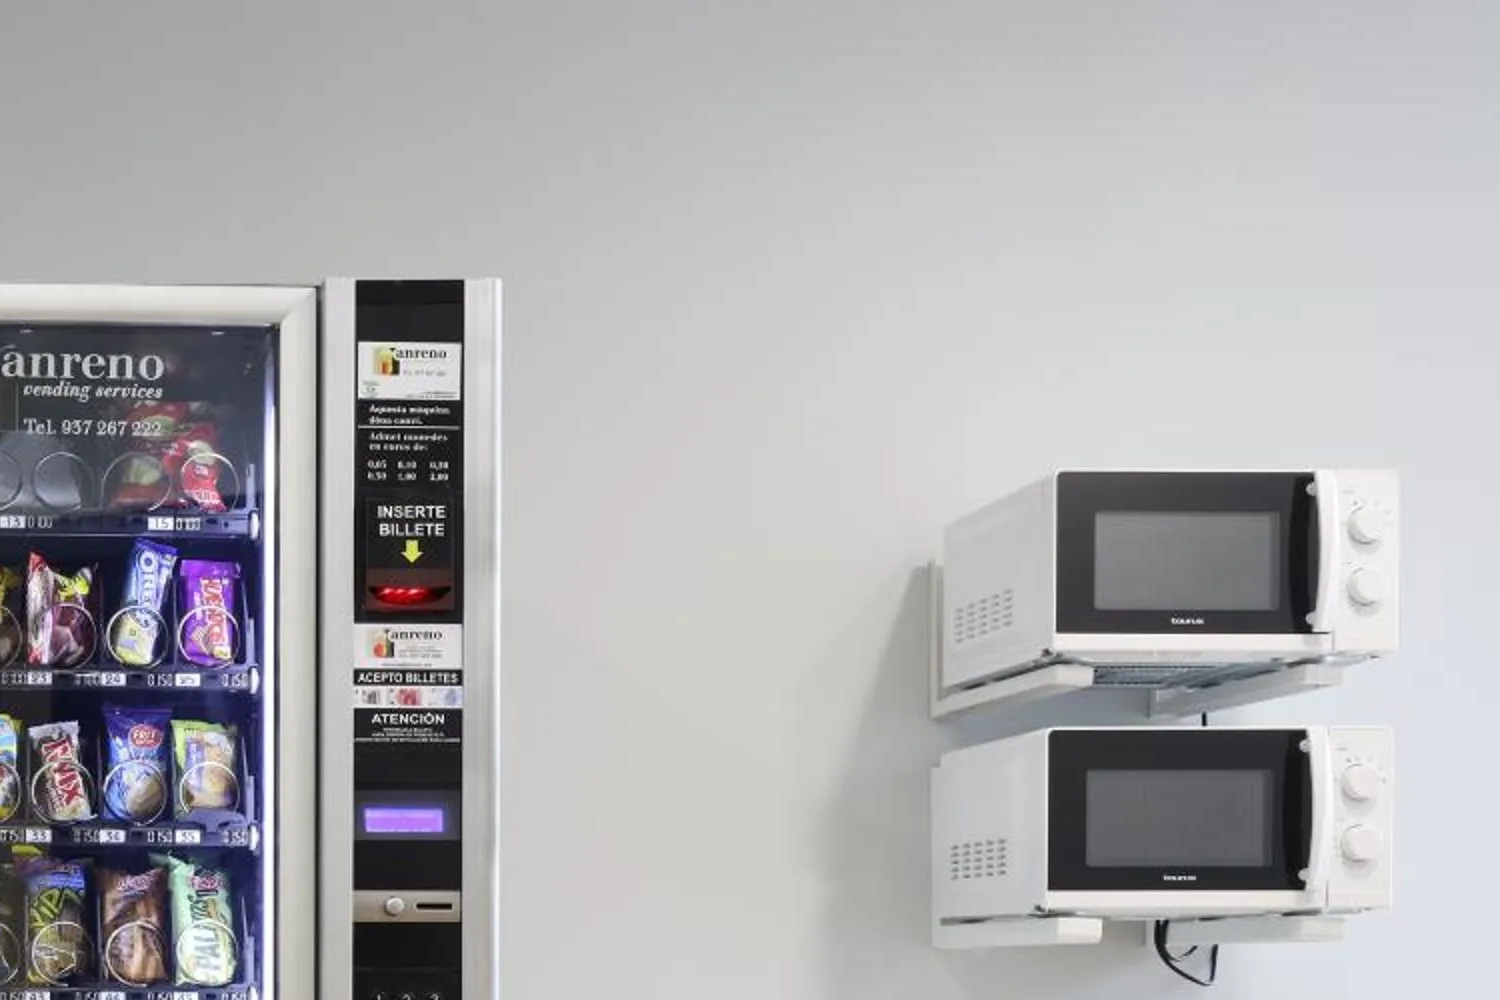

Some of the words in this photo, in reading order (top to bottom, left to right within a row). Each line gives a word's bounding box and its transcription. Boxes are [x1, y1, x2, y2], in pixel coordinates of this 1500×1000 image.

[395, 349, 447, 359] anreno
[1, 352, 165, 380] anreno
[23, 381, 92, 403] vending
[95, 384, 163, 399] services
[61, 420, 93, 435] 937
[96, 421, 127, 436] 267
[132, 422, 162, 437] 222
[377, 505, 446, 519] INSERTE
[379, 523, 445, 537] BILLETE
[358, 672, 403, 685] ACEPTO
[405, 672, 458, 685] BILLETES
[372, 712, 445, 725] ATENCIÓN
